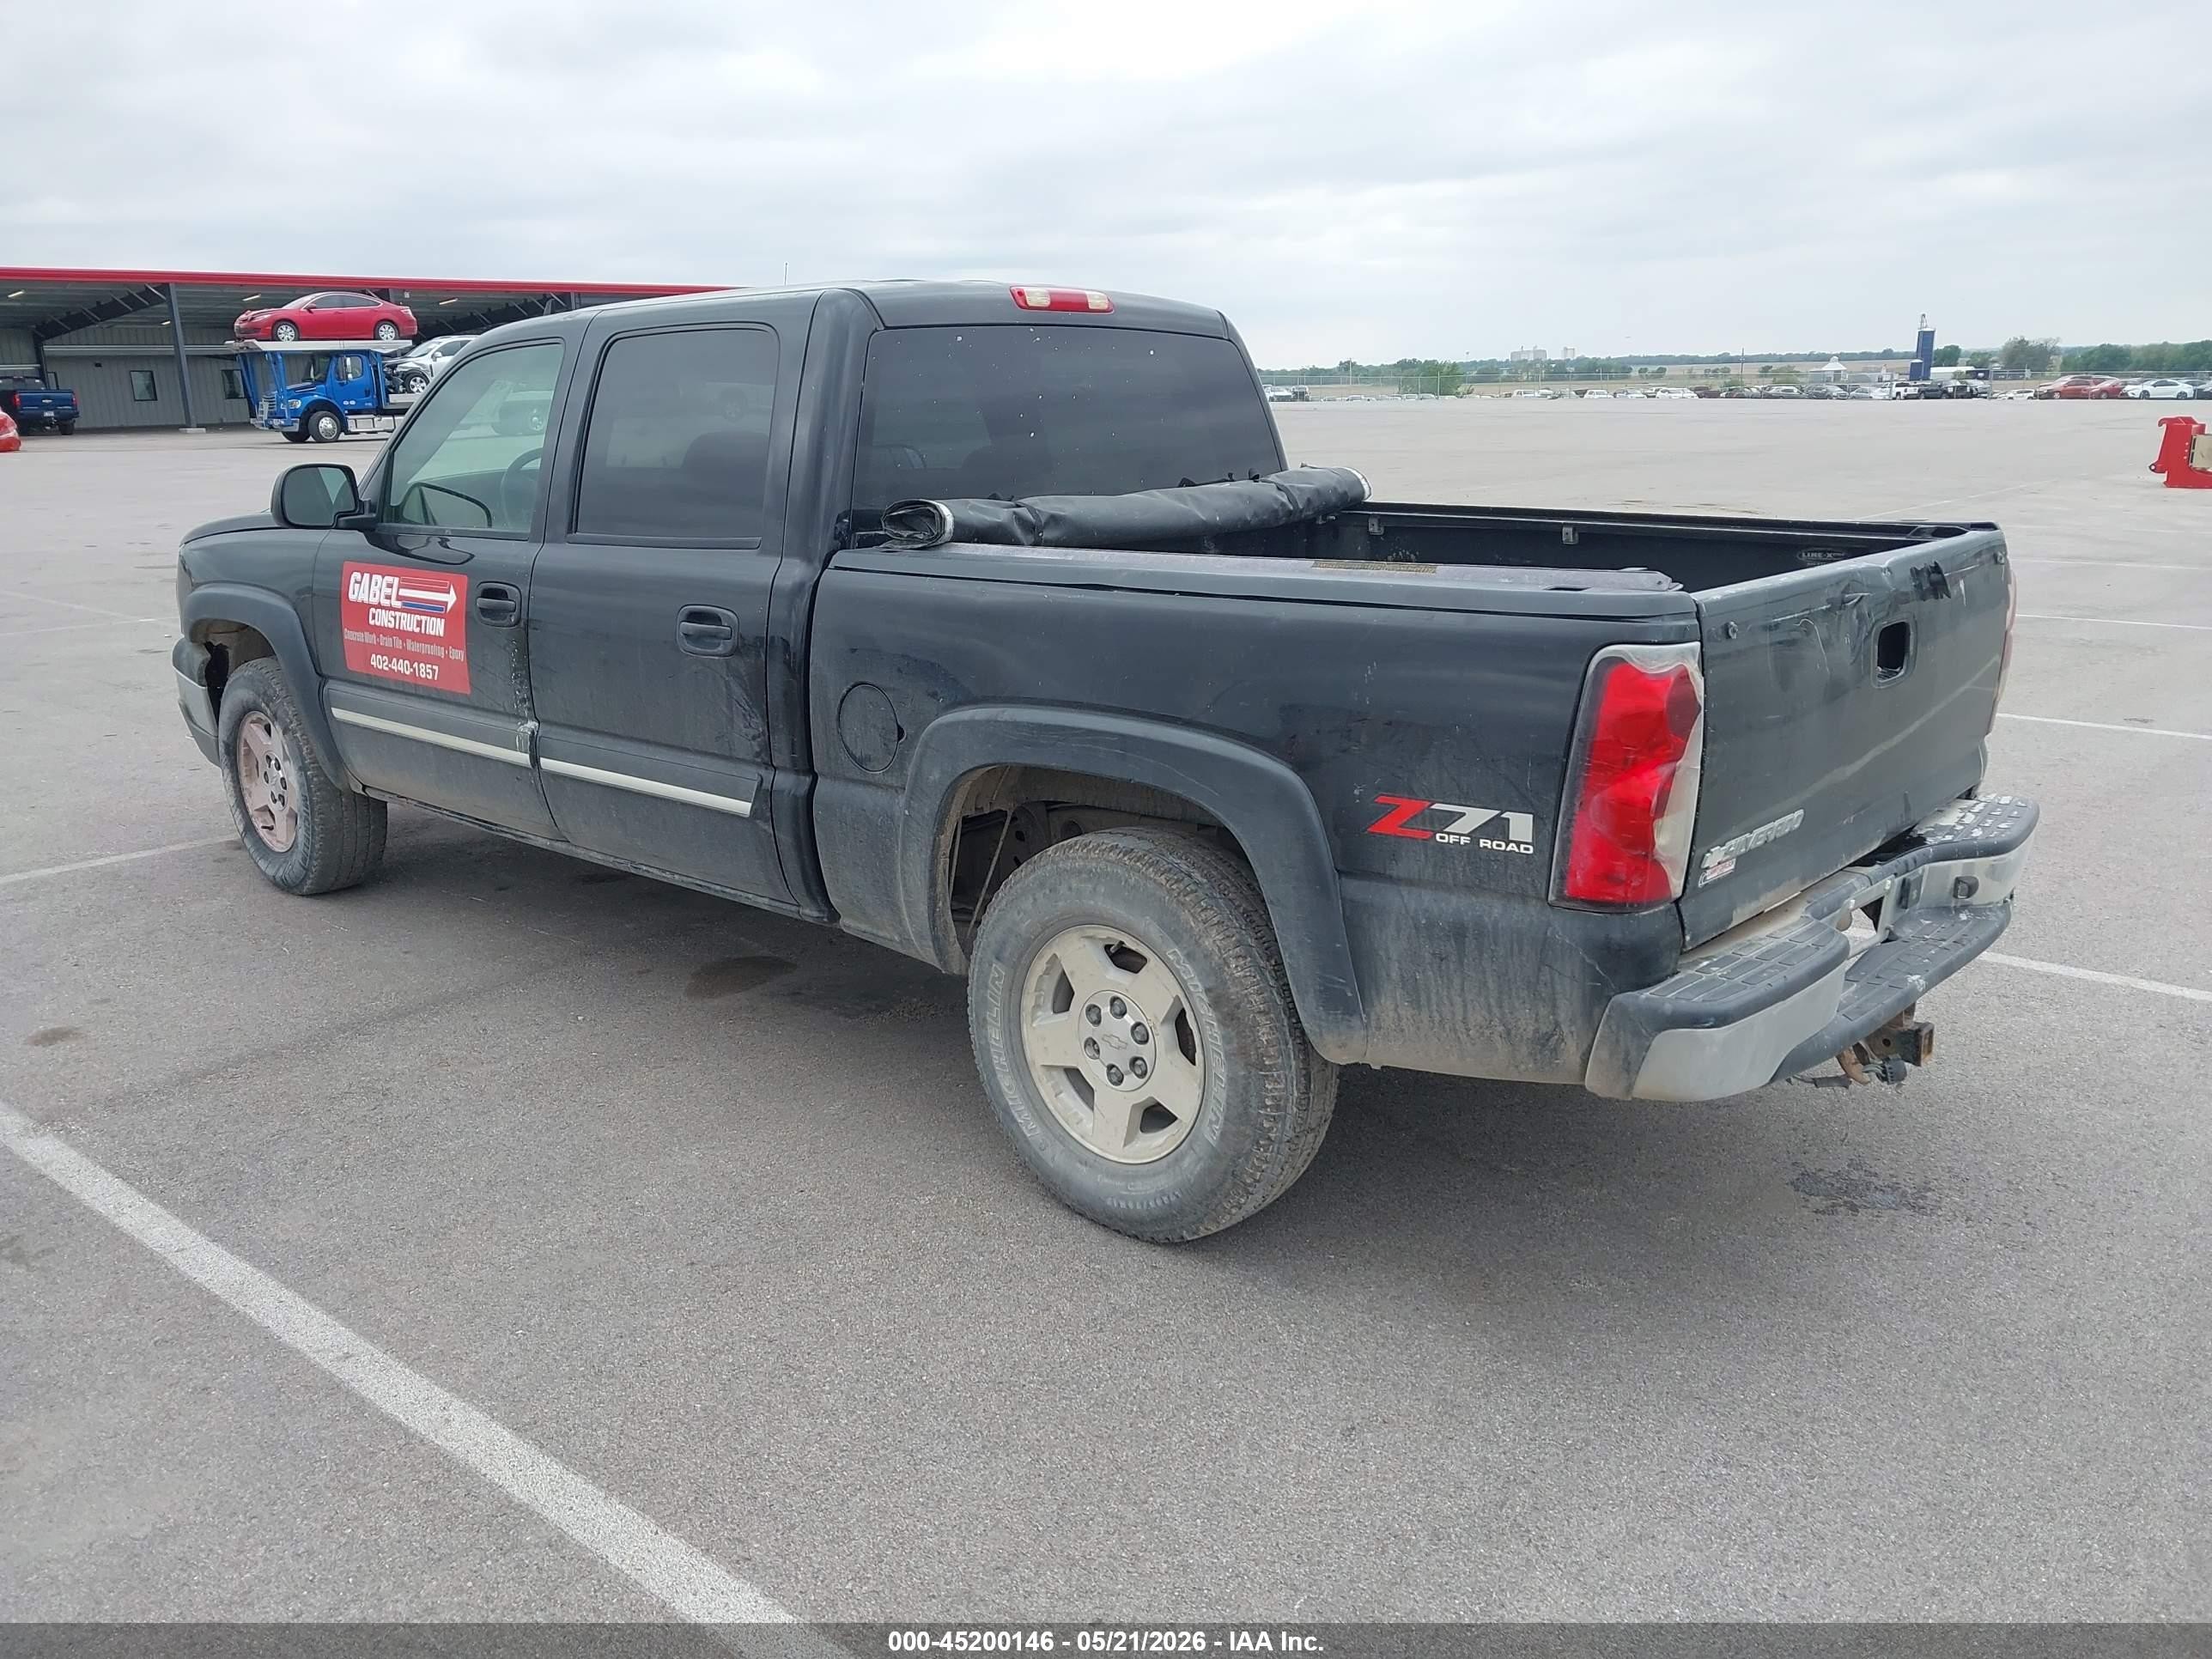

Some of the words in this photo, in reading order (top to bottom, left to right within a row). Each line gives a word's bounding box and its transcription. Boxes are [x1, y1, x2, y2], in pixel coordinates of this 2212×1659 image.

[348, 571, 403, 609] GABEL
[368, 607, 446, 637] CONSTRUCTION
[380, 634, 392, 647] Drain
[392, 636, 403, 649] Tile
[406, 638, 445, 658] Waterproofing
[449, 646, 465, 662] Epoxy
[370, 653, 439, 681] 402-440-1857
[1366, 795, 1534, 843] Z71
[1435, 832, 1471, 846] OFF
[1479, 838, 1534, 854] ROAD
[986, 960, 1040, 1139] MICHELIN
[1166, 947, 1227, 1148] MICHELIN
